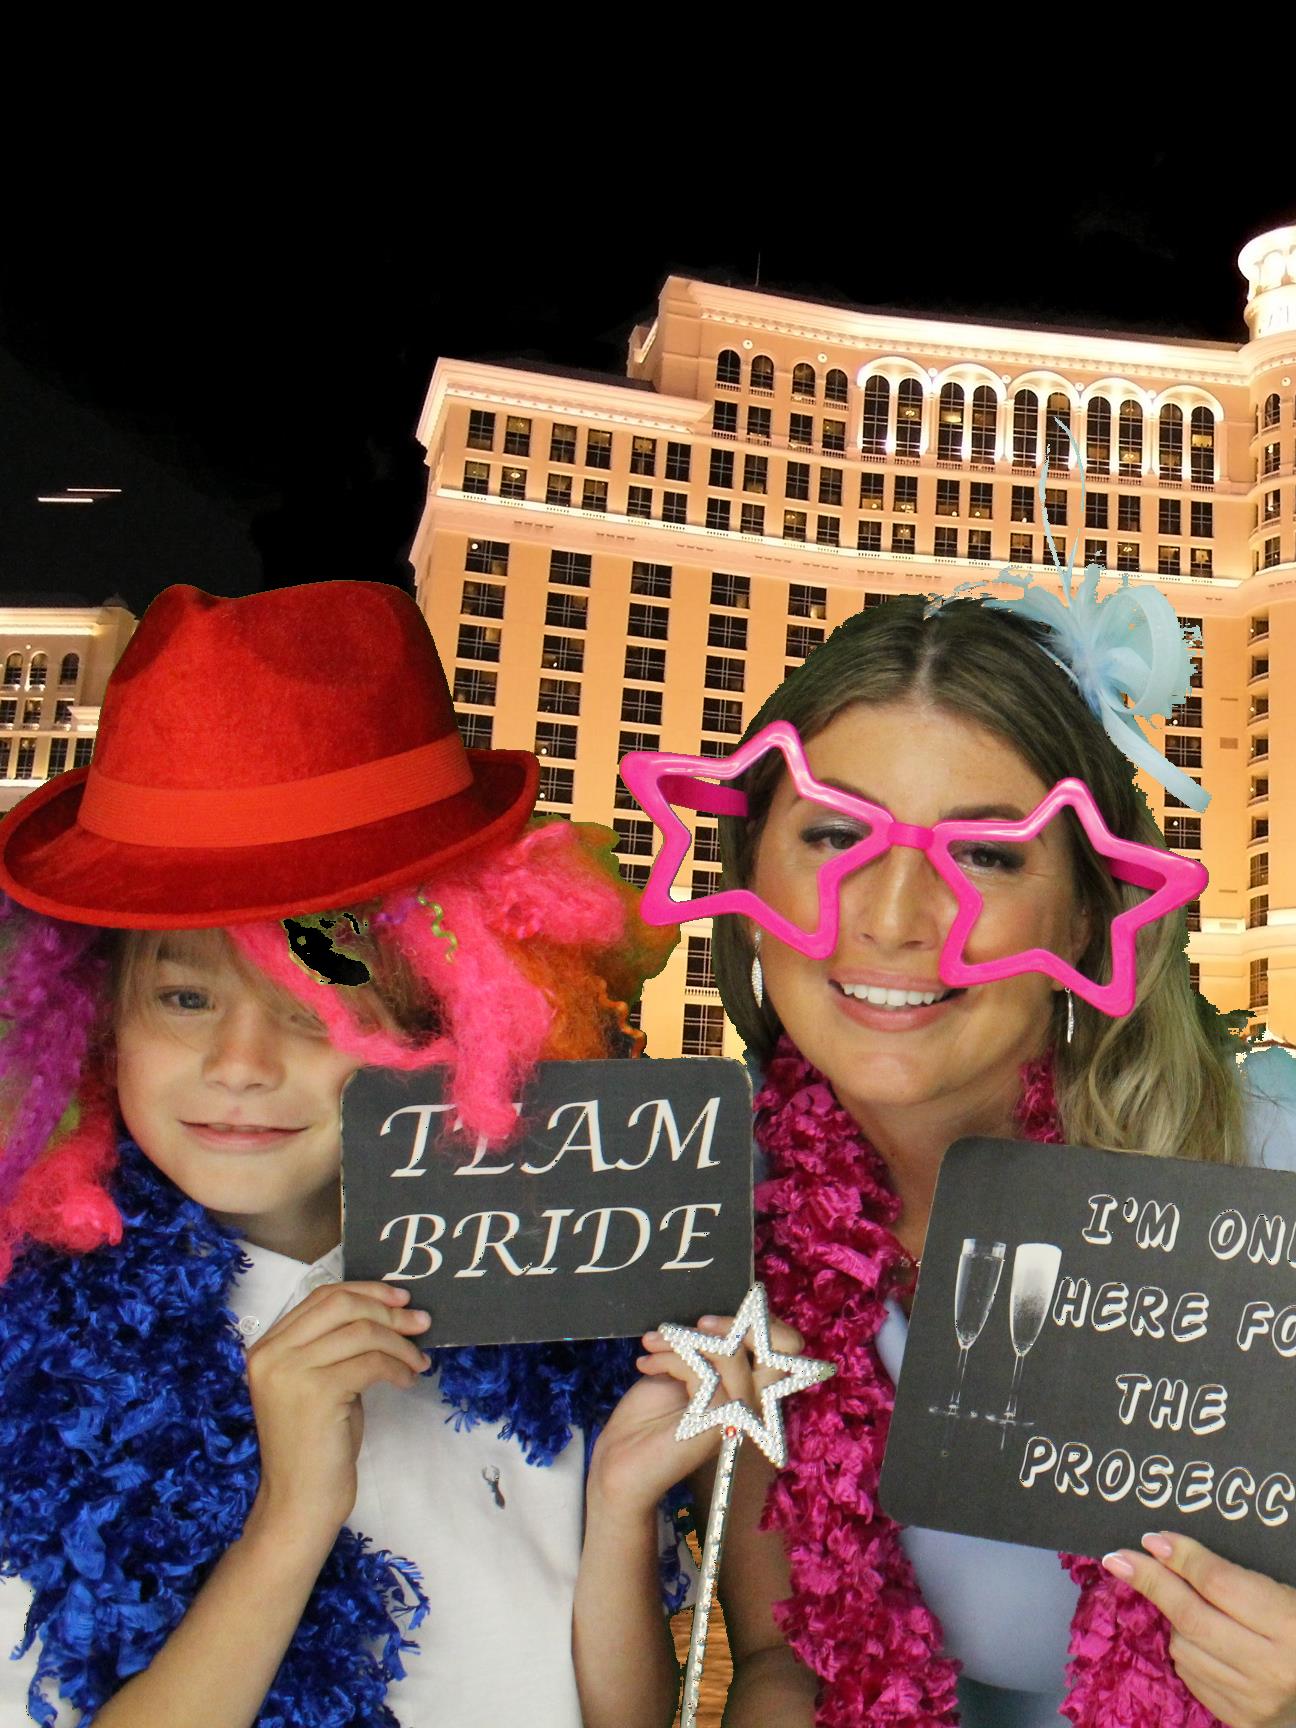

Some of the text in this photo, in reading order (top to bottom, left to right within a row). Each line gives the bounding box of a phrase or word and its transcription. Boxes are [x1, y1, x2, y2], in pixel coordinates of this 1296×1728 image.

[379, 1203, 722, 1281] BRIDE
[1081, 1194, 1181, 1253] I'M
[1052, 1276, 1210, 1343] HERE
[1115, 1373, 1228, 1435] THE
